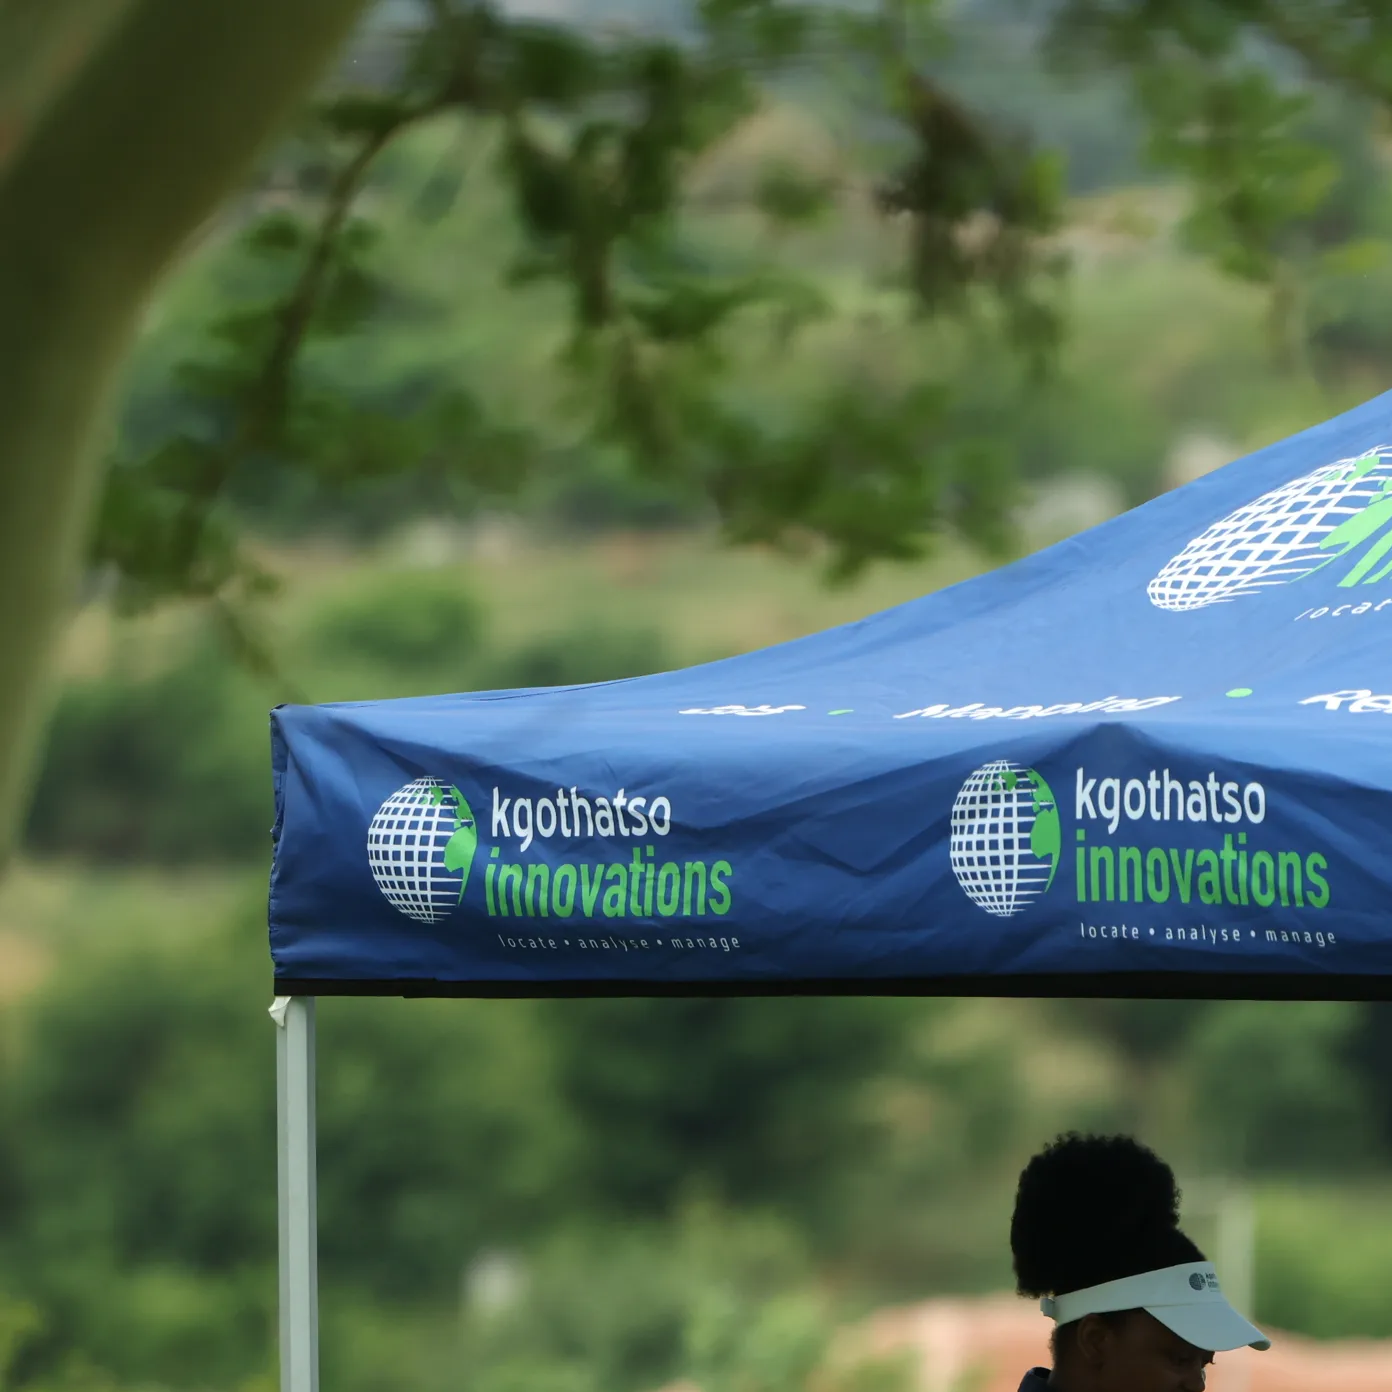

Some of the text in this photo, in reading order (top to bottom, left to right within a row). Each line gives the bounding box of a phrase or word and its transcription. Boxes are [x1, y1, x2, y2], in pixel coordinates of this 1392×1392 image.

[491, 786, 671, 852] kgothatso
[1075, 767, 1265, 834] kgothatso
[485, 845, 733, 917] innovations
[1076, 829, 1330, 908] innovations
[498, 934, 741, 952] locate analyse manage
[1080, 922, 1336, 947] locate analyse manage
